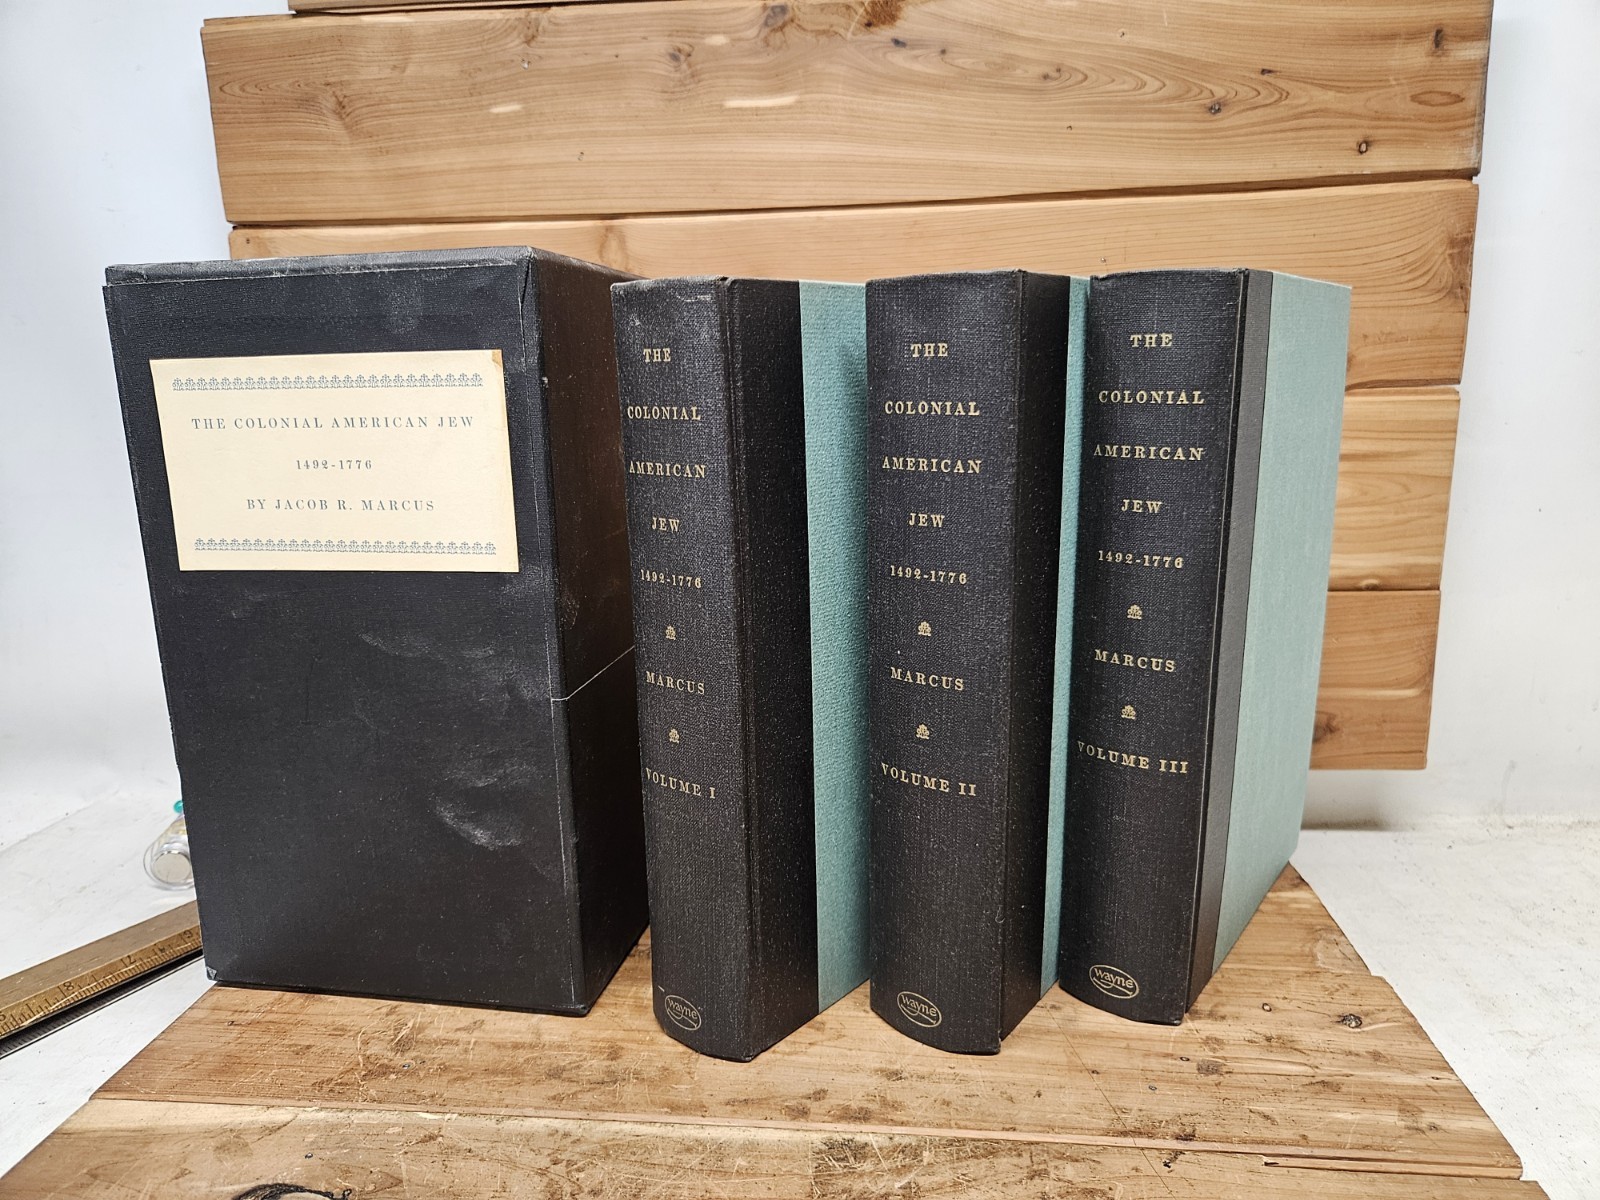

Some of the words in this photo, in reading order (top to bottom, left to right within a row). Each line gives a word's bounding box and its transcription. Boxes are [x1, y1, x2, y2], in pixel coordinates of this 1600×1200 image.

[1130, 333, 1173, 348] THE
[643, 347, 672, 363] THE
[910, 342, 949, 358] THE
[1098, 389, 1205, 405] COLONIAL
[627, 405, 702, 421] COLONIAL
[884, 400, 980, 416] COLONIAL
[191, 417, 226, 430] THE
[233, 416, 324, 429] COLONIAL
[330, 415, 429, 429] AMERICAN
[437, 415, 475, 428] JEW
[1093, 444, 1204, 461] AMERICAN
[296, 459, 373, 470] 1492-1776
[629, 460, 706, 479] AMERICAN
[882, 455, 982, 474] AMERICAN
[246, 498, 267, 510] BY
[274, 498, 329, 511] JACOB
[337, 499, 353, 511] R.
[361, 499, 435, 512] MARCUS
[1121, 499, 1163, 514] JEW
[651, 516, 680, 532] JEW
[909, 512, 945, 528] JEW
[1098, 550, 1184, 569] 1492-1776
[640, 569, 702, 589] 1492-1776
[890, 564, 967, 585] 1492-1776
[1094, 649, 1175, 672] MARCUS
[645, 670, 705, 695] MARCUS
[890, 666, 964, 691] MARCUS
[1077, 740, 1150, 770] VOLUME
[1158, 759, 1189, 774] III
[645, 767, 701, 797] VOLUME
[709, 786, 716, 799] I
[881, 762, 950, 793] VOLUME
[958, 782, 977, 797] II
